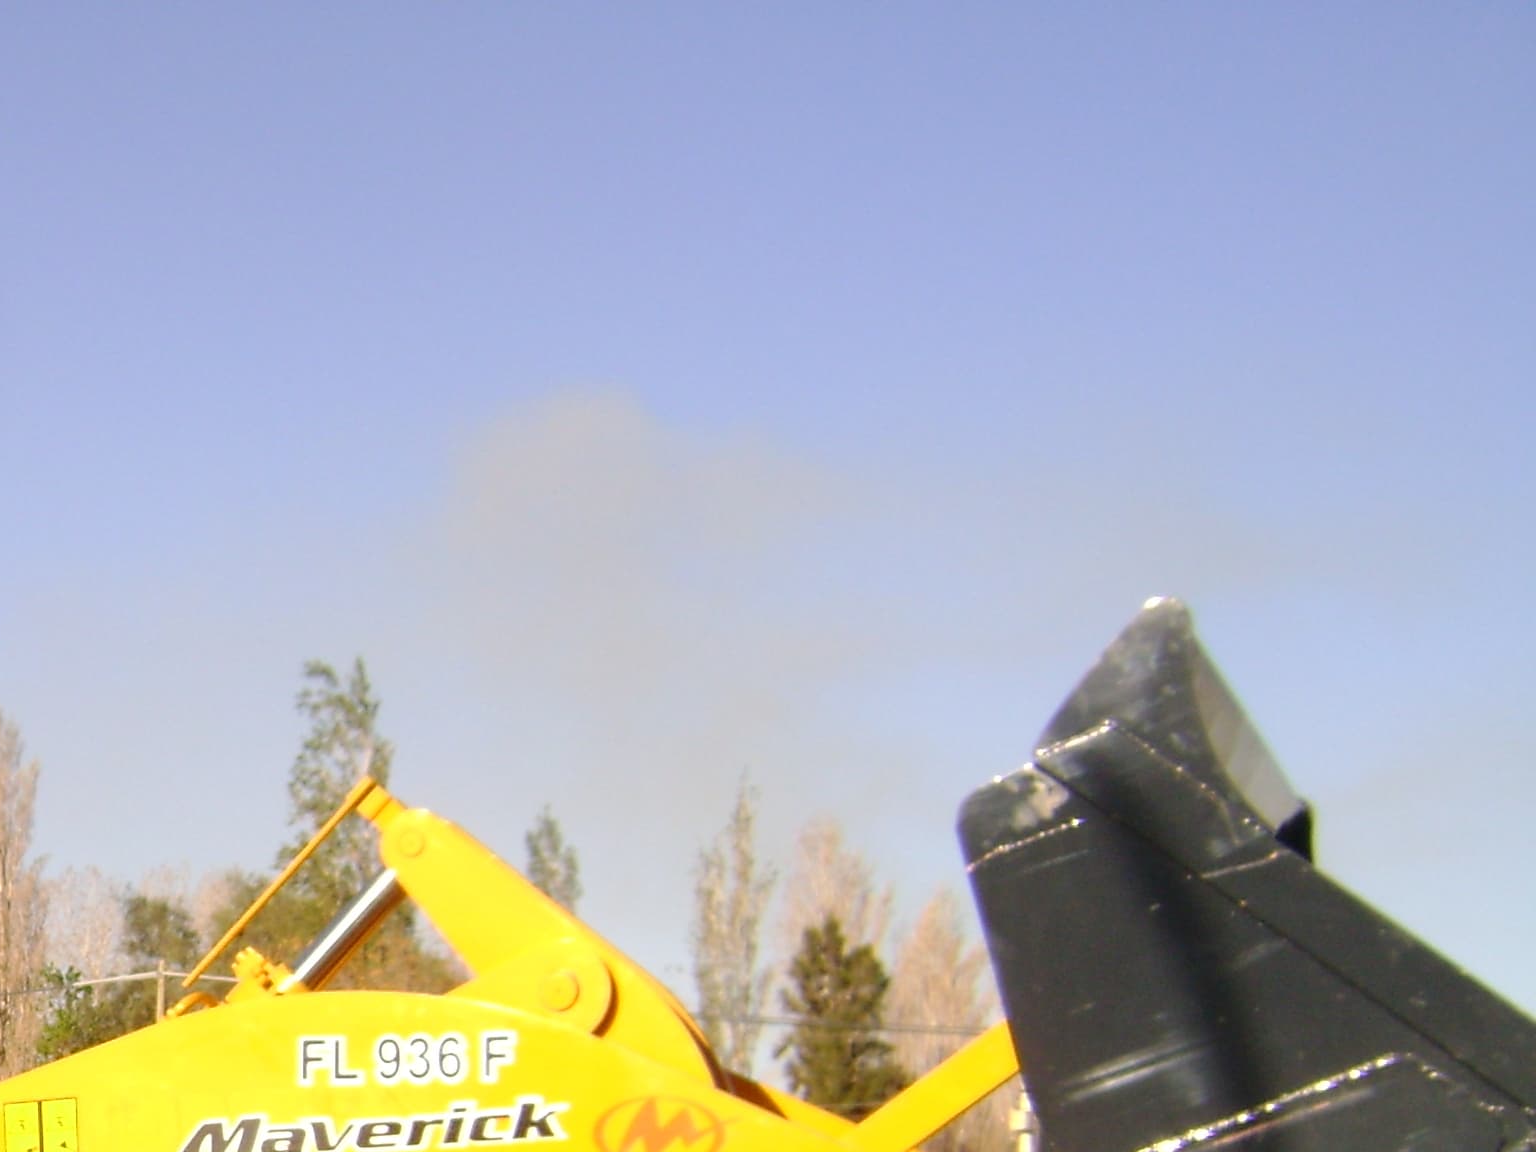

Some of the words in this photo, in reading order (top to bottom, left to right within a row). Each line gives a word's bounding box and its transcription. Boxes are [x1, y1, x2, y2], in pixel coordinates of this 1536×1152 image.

[301, 1039, 359, 1080] FL
[377, 1036, 462, 1079] 936
[483, 1035, 511, 1078] F
